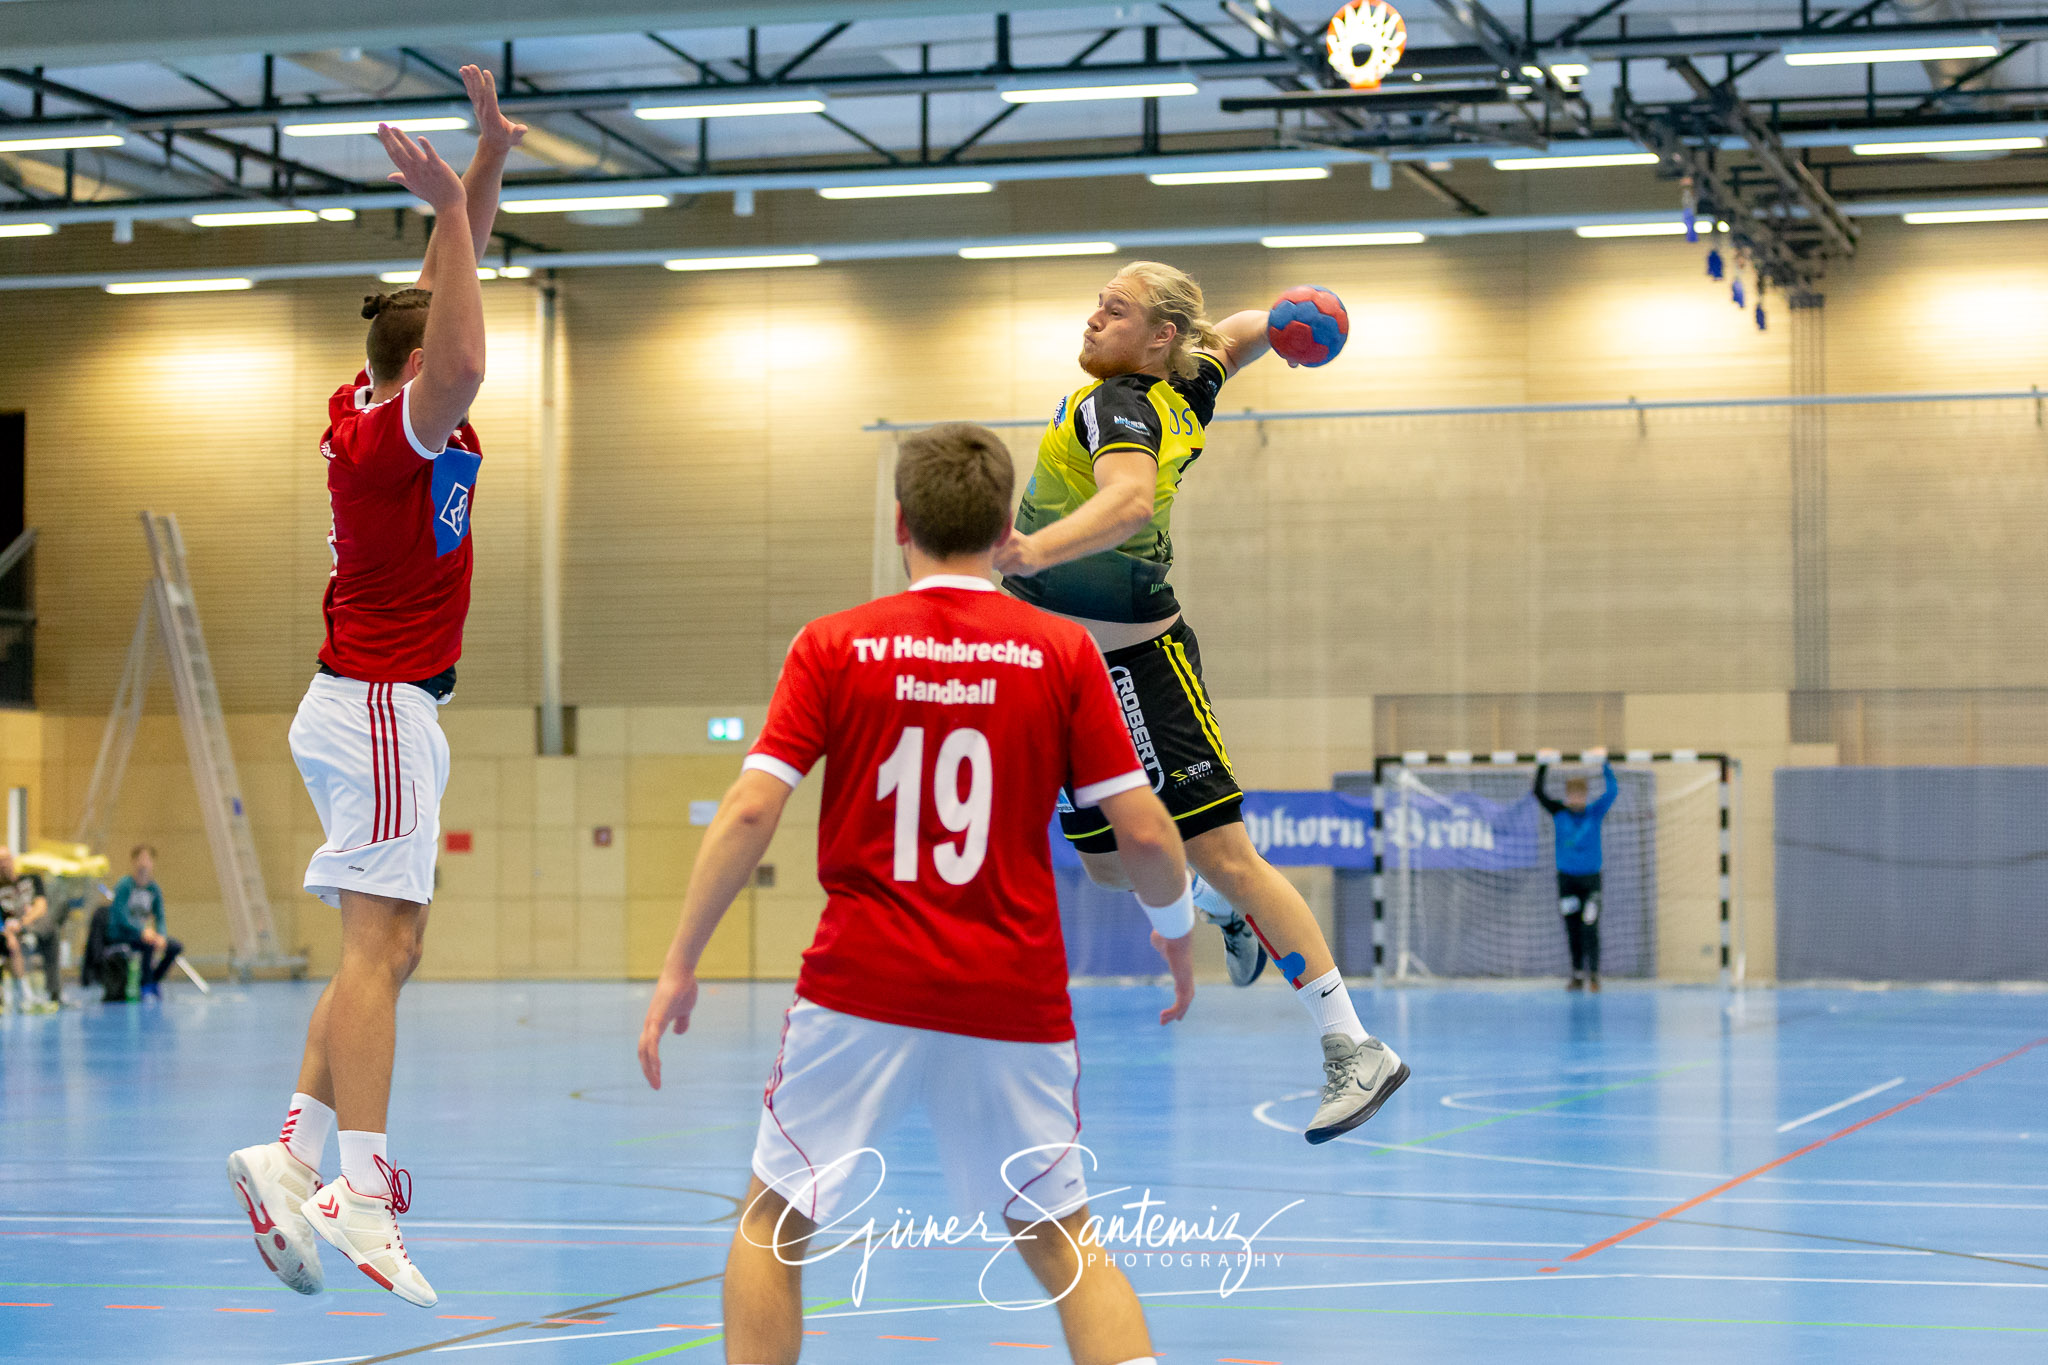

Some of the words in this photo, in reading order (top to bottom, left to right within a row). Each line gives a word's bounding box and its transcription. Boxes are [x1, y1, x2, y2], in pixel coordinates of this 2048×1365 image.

[852, 636, 888, 663] TV
[893, 634, 1044, 669] Helmbrechts
[896, 673, 997, 705] Handball
[1116, 675, 1162, 772] ROBERT
[1187, 760, 1211, 776] SEVEN
[876, 726, 993, 885] 19
